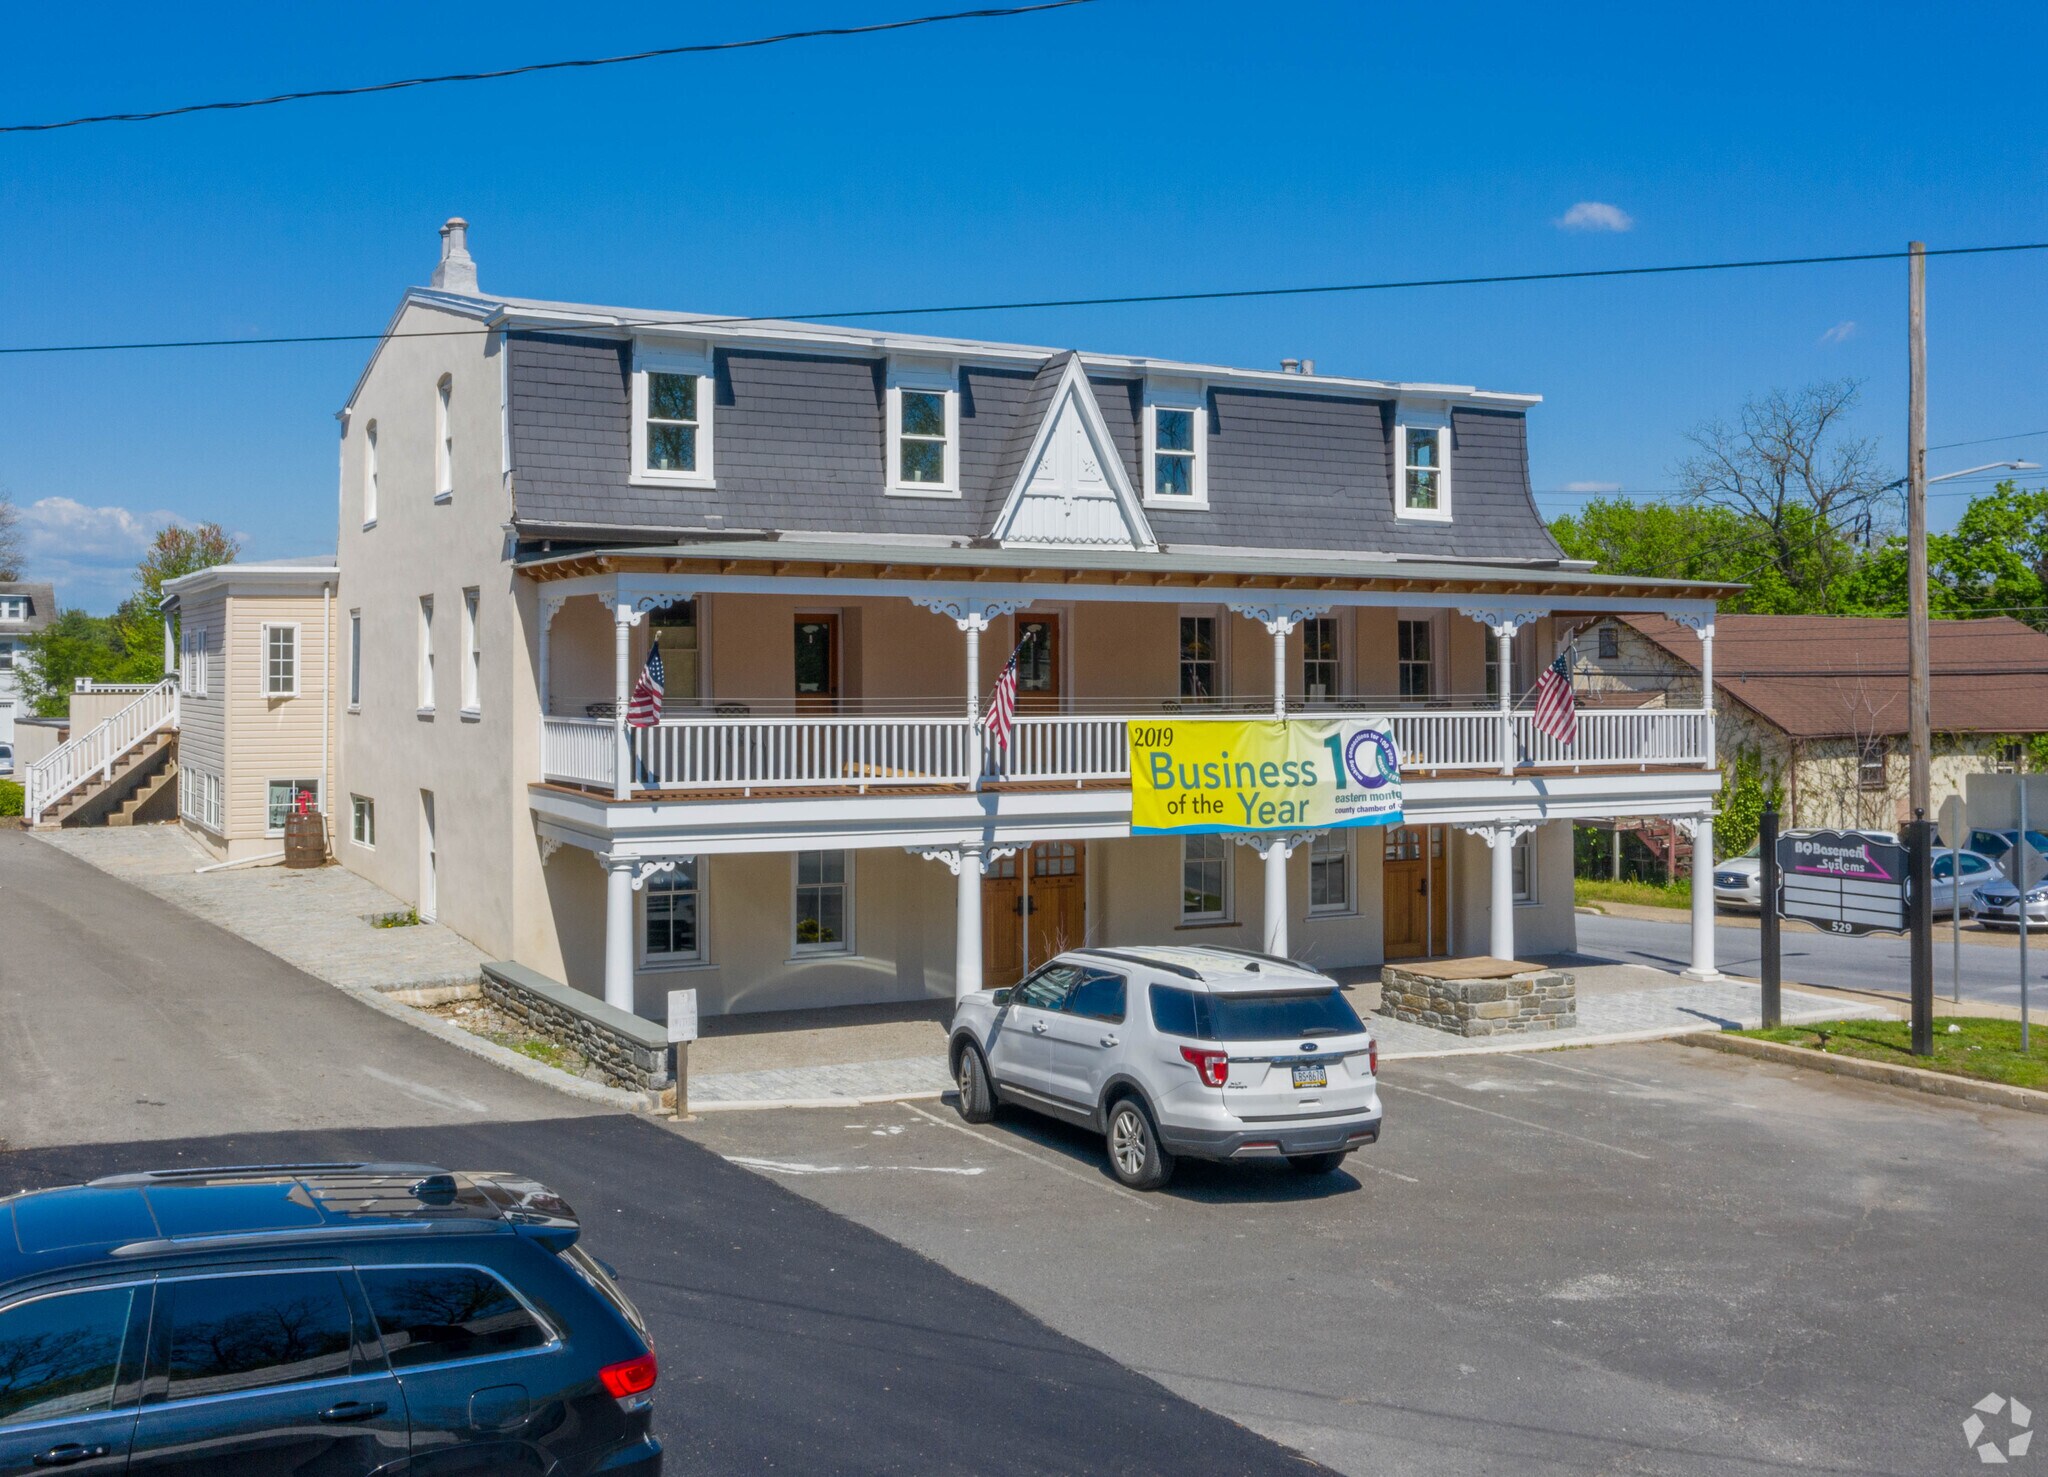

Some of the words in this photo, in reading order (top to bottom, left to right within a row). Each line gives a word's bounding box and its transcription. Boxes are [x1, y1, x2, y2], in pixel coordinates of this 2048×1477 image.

[1135, 727, 1174, 747] 2019
[1379, 738, 1390, 749] 100
[1385, 748, 1394, 766] years
[1150, 751, 1318, 790] Business
[1167, 794, 1187, 815] of
[1193, 794, 1224, 814] the
[1335, 792, 1367, 803] eastern
[1237, 791, 1310, 825] Year
[1335, 806, 1355, 815] county
[1357, 804, 1386, 813] chamber
[1389, 802, 1396, 810] of
[1817, 857, 1865, 874] Systems
[1831, 921, 1852, 933] 529
